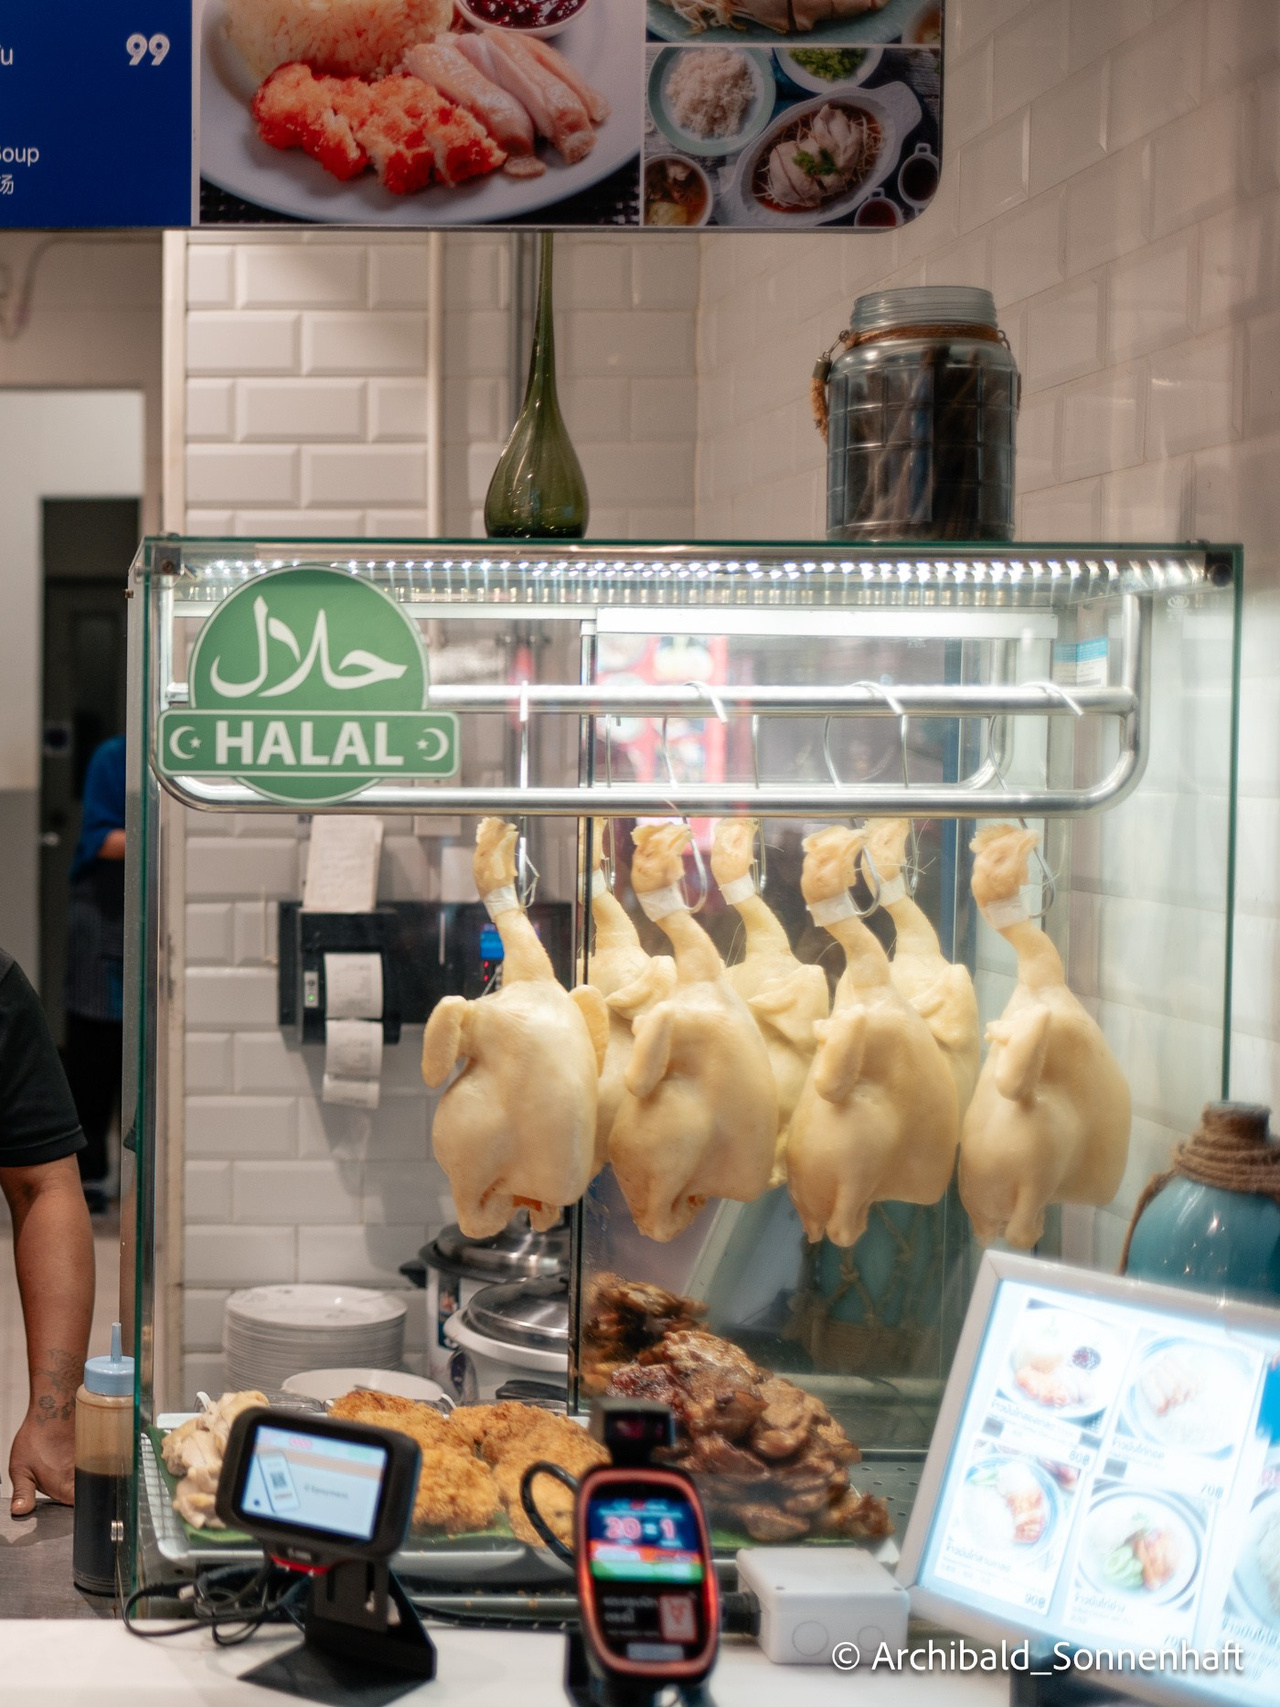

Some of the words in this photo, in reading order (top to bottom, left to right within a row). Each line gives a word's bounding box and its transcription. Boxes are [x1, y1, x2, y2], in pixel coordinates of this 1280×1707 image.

[125, 33, 171, 66] 99
[209, 595, 408, 698] حلال
[215, 720, 404, 766] HALAL
